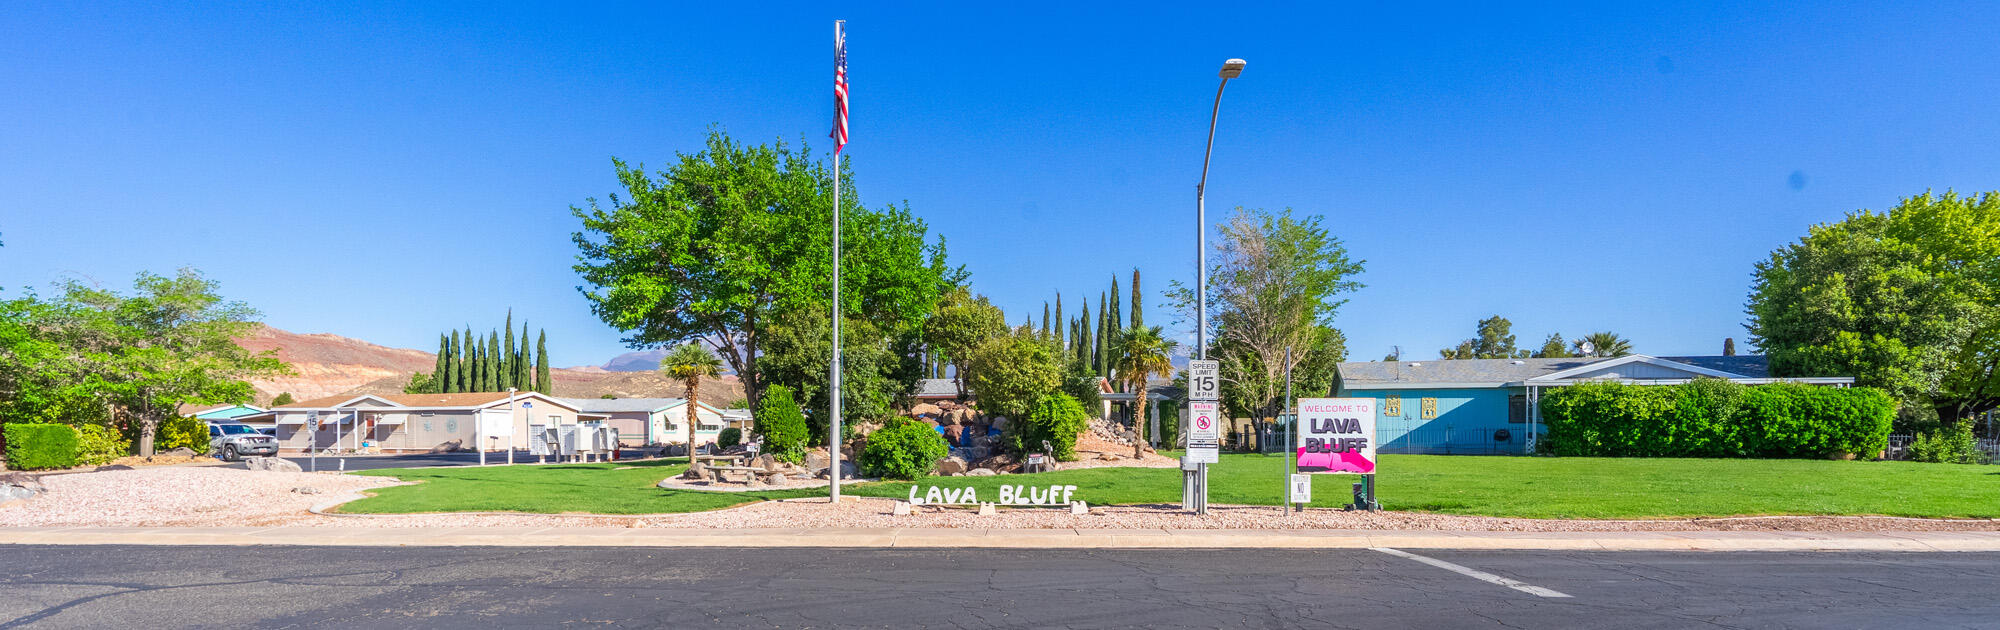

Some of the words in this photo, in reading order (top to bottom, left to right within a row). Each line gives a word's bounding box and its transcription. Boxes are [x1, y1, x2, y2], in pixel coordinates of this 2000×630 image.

[1193, 376, 1215, 391] 15
[1304, 405, 1352, 413] WELCOME
[1356, 405, 1368, 413] TO
[1310, 418, 1362, 434] LAVA
[1305, 437, 1368, 454] BLUFF
[909, 485, 977, 505] LAVA
[999, 484, 1077, 505] BLUFF
